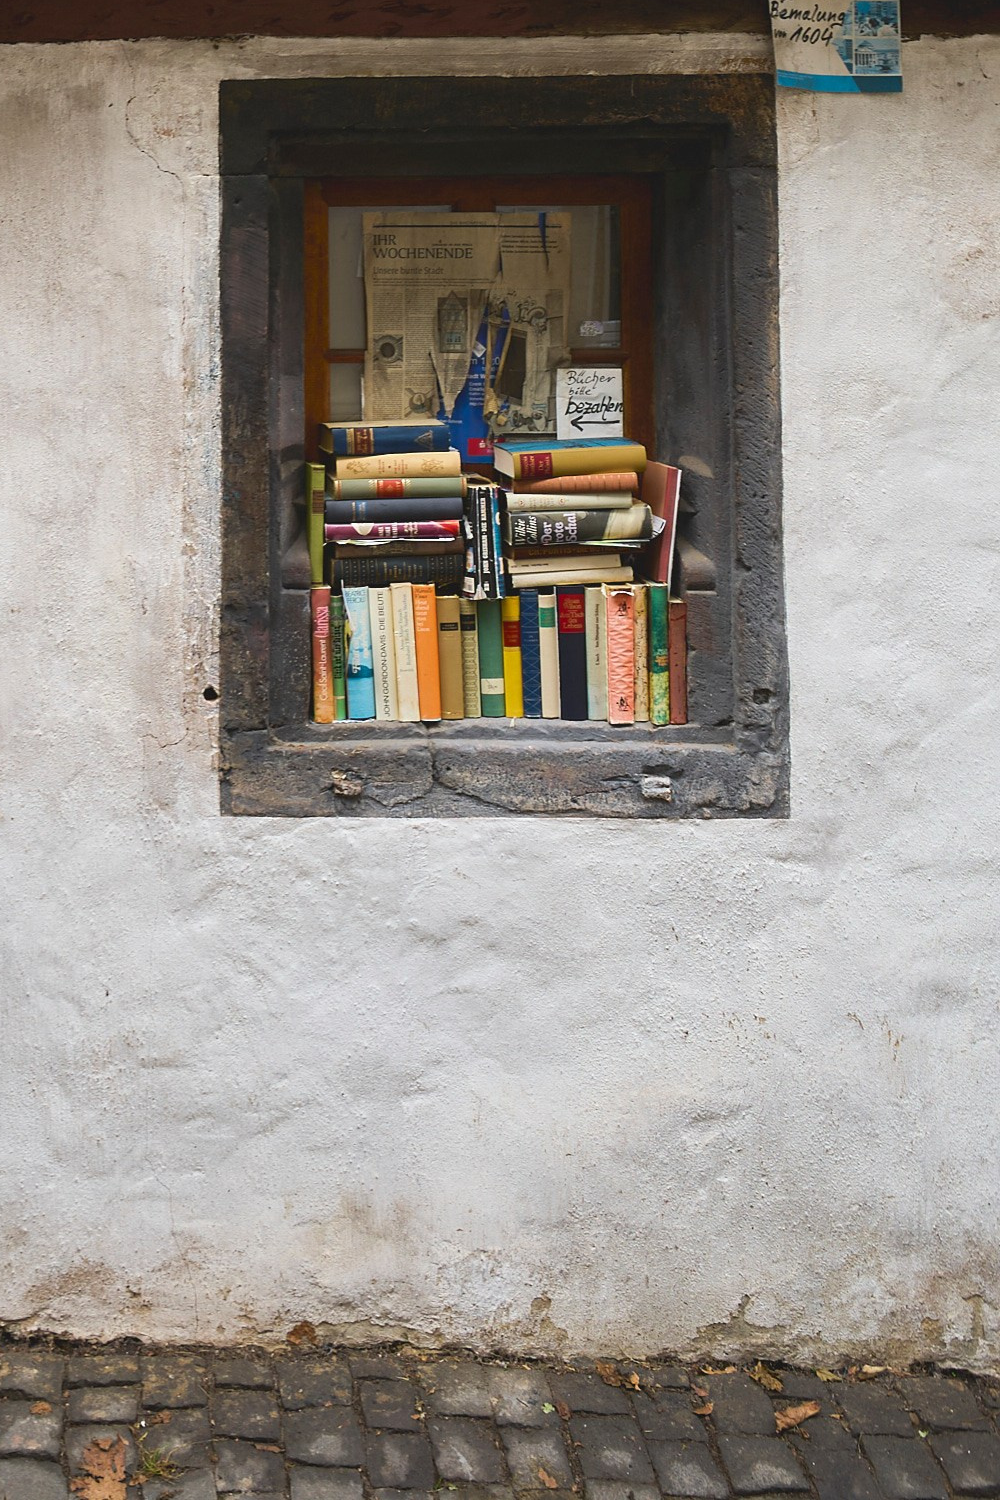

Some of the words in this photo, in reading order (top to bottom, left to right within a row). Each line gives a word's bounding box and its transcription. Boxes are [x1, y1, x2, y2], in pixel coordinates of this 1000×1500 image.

[770, 0, 846, 29] Bemalung
[789, 25, 834, 47] 1604
[372, 234, 397, 246] IHR
[372, 247, 474, 260] WOCHENENDE
[372, 266, 398, 275] Unsere
[423, 266, 444, 275] Stadt
[565, 370, 616, 390] Bücher
[568, 386, 592, 396] bitte
[564, 396, 624, 421] bezahlen
[479, 497, 487, 521] KAMMER
[514, 517, 526, 545] Wilkie
[526, 515, 538, 545] Collins
[541, 521, 552, 545] Der
[554, 521, 565, 543] rote
[563, 512, 578, 543] Schal
[481, 534, 489, 560] GRISHAM
[482, 559, 491, 574] JOHN
[376, 591, 385, 616] BEUTE
[378, 617, 386, 631] DIE
[318, 639, 328, 684] Saint-Laurent
[379, 634, 389, 695] GORDON-DAVIS
[383, 695, 391, 718] JOHN
